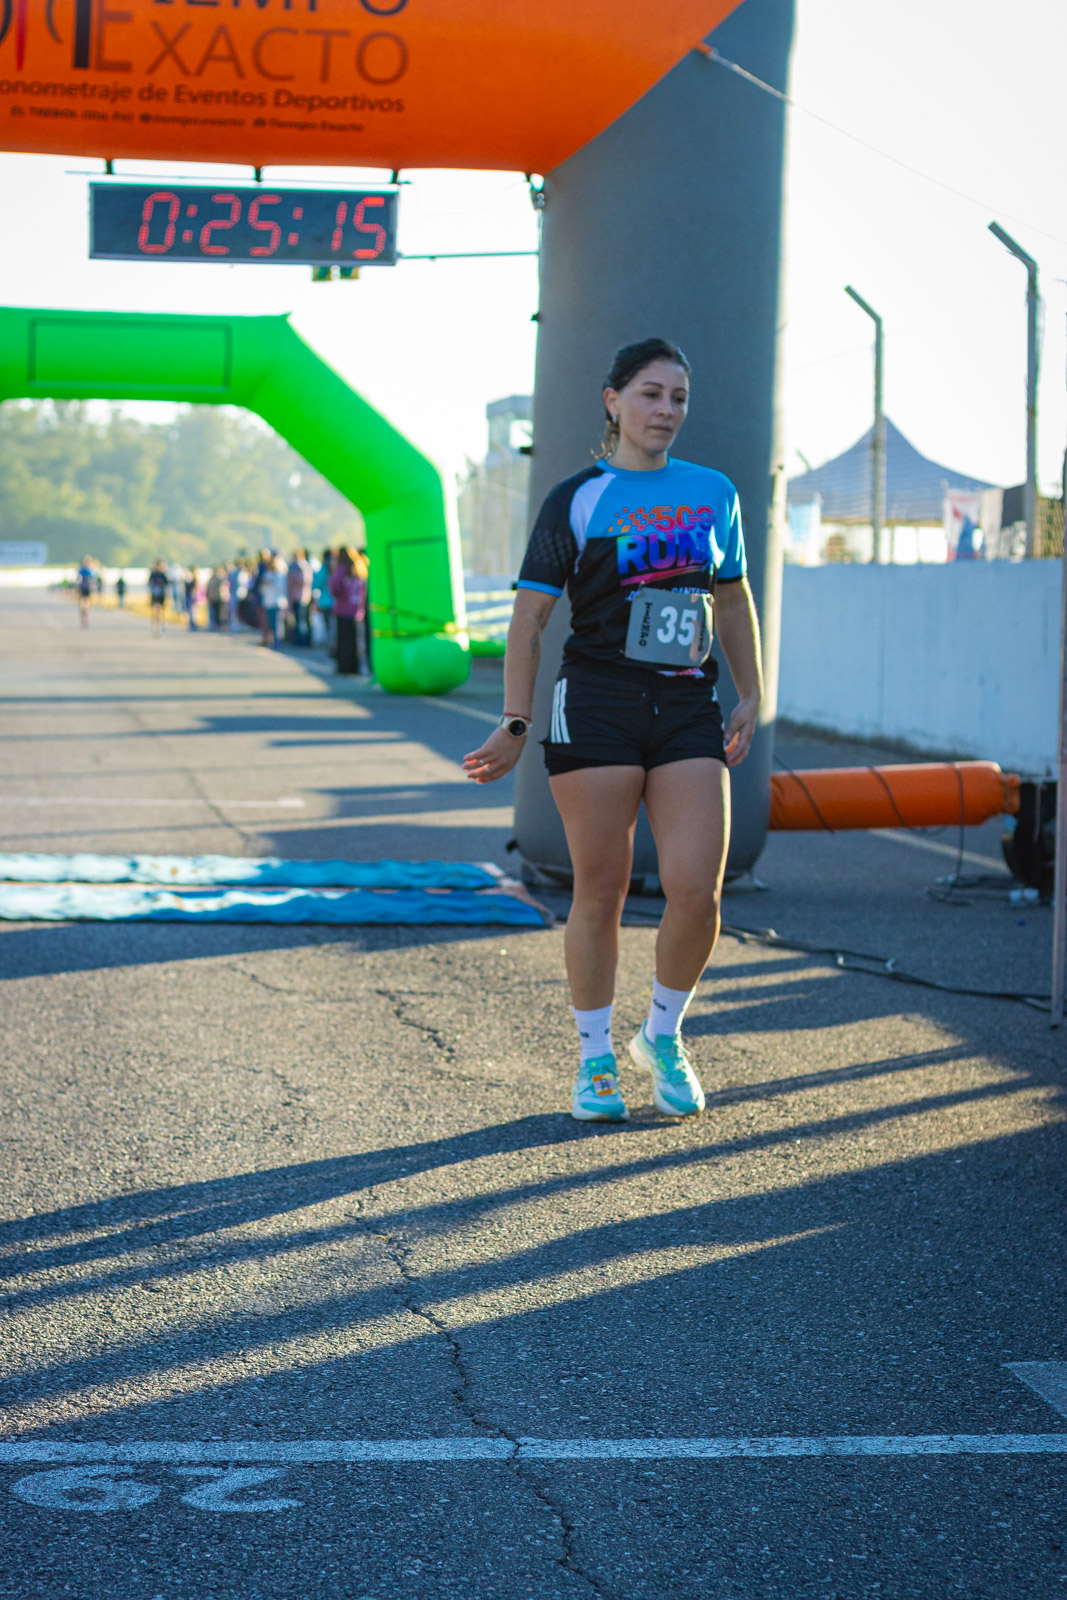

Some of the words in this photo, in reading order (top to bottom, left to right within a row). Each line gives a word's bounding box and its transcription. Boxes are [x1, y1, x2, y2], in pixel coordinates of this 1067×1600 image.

[137, 83, 168, 102] de
[174, 84, 267, 107] Eventos
[274, 88, 404, 113] Deportivos
[138, 192, 387, 259] 0:25:15
[616, 533, 712, 575] RUN
[657, 606, 698, 647] 35
